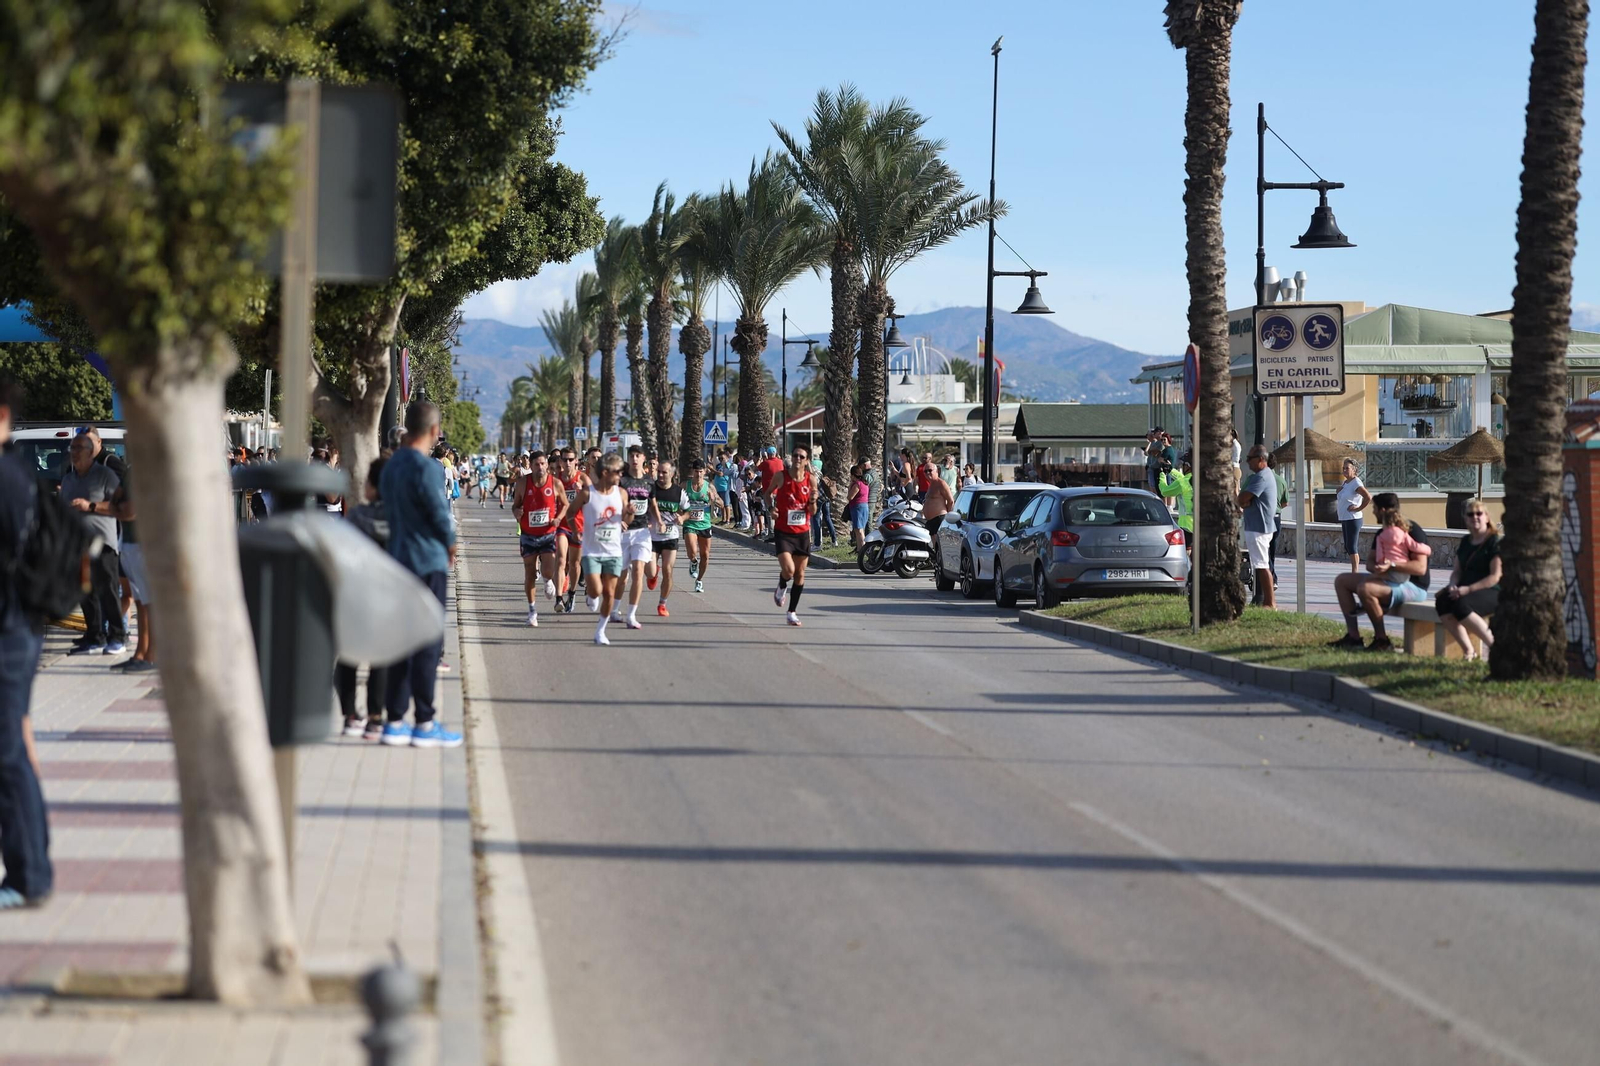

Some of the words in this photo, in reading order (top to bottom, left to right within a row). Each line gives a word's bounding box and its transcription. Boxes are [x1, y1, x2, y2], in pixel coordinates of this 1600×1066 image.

[1260, 356, 1297, 364] BICICLETAS
[1307, 355, 1334, 363] PATINES
[1267, 368, 1284, 378] EN
[1287, 367, 1333, 377] CARRIL
[1261, 378, 1339, 390] SEÑALIZADO
[531, 514, 547, 523] 437
[602, 530, 612, 538] 14
[1108, 569, 1129, 579] 2982
[1131, 569, 1147, 578] HRT
